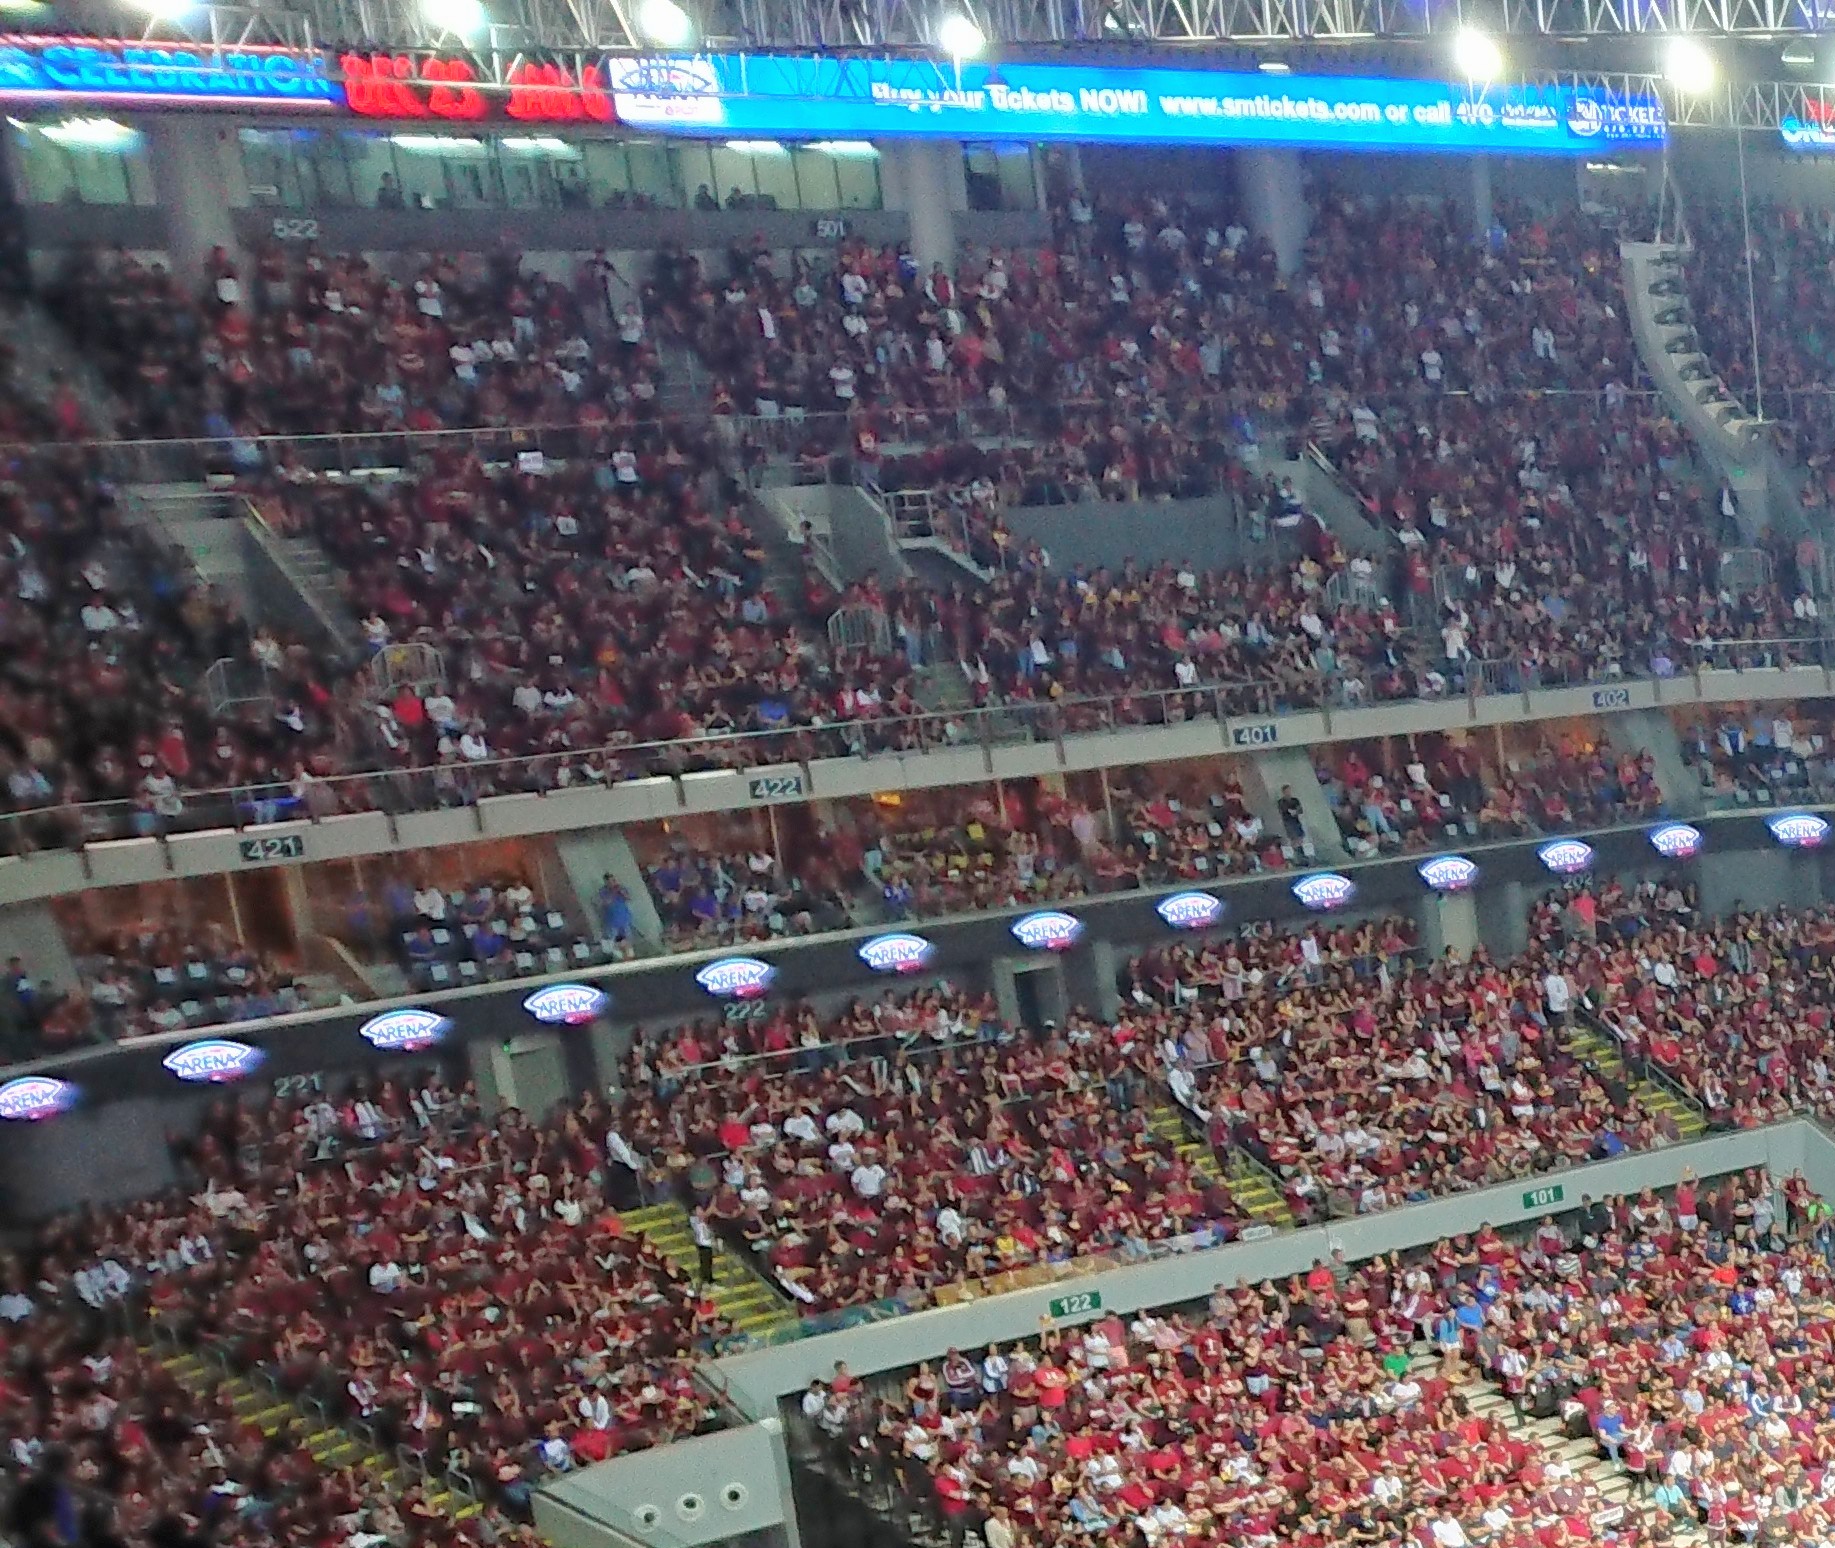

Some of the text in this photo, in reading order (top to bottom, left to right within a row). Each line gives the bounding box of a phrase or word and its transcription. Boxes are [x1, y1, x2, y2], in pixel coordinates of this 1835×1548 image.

[1080, 88, 1148, 115] NOW!
[1160, 95, 1381, 124] www.smtickets.com
[1385, 103, 1409, 123] or
[1413, 100, 1452, 124] call
[1594, 690, 1627, 709] 402
[1237, 725, 1276, 745] 401
[753, 778, 802, 799] 422
[1780, 826, 1821, 840] ARENA
[247, 837, 302, 858] 421
[1549, 850, 1590, 867] ARENA
[1429, 869, 1470, 884] ARENA
[872, 948, 920, 965] ARENA
[708, 972, 760, 989] ARENA
[537, 999, 590, 1016] ARENA
[724, 1001, 767, 1020] 222
[374, 1022, 433, 1042] ARENA
[179, 1053, 241, 1075] ARENA
[274, 1071, 320, 1098] 221
[1530, 1189, 1556, 1206] 101
[1059, 1294, 1091, 1313] 122
